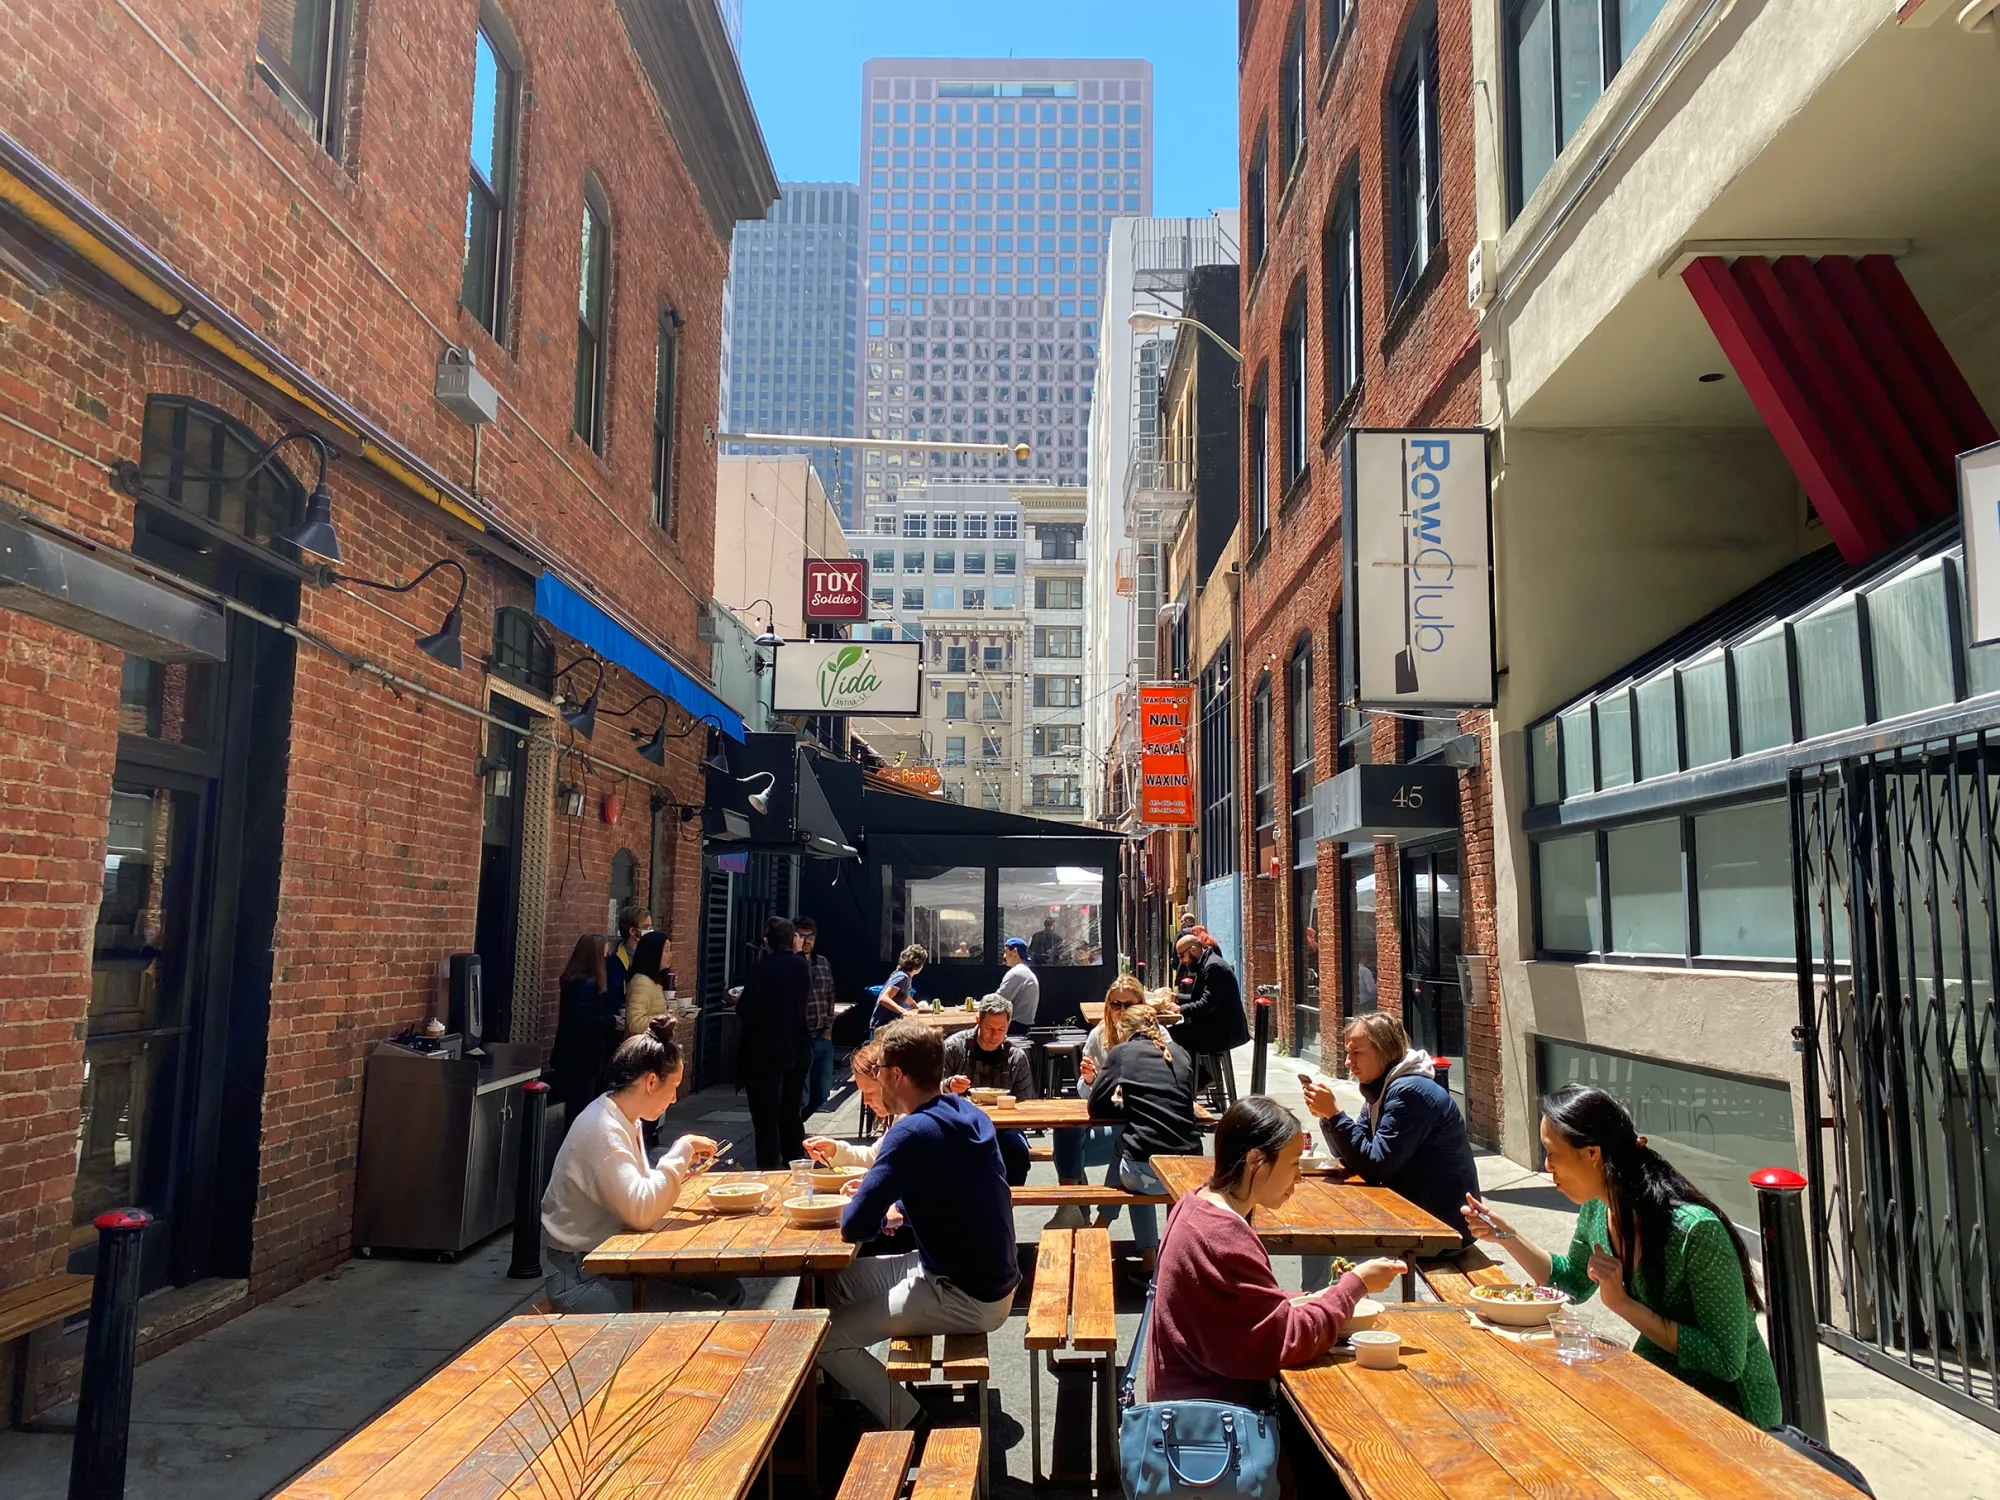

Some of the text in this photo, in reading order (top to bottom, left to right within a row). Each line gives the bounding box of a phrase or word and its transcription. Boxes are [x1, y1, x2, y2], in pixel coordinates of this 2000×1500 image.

[811, 572, 859, 592] TOY
[811, 593, 859, 606] Soldier
[820, 656, 883, 708] Vida
[1149, 713, 1182, 726] NAIL
[1148, 743, 1185, 755] FACIAL
[1145, 774, 1188, 787] WAXING
[1391, 784, 1424, 809] 45
